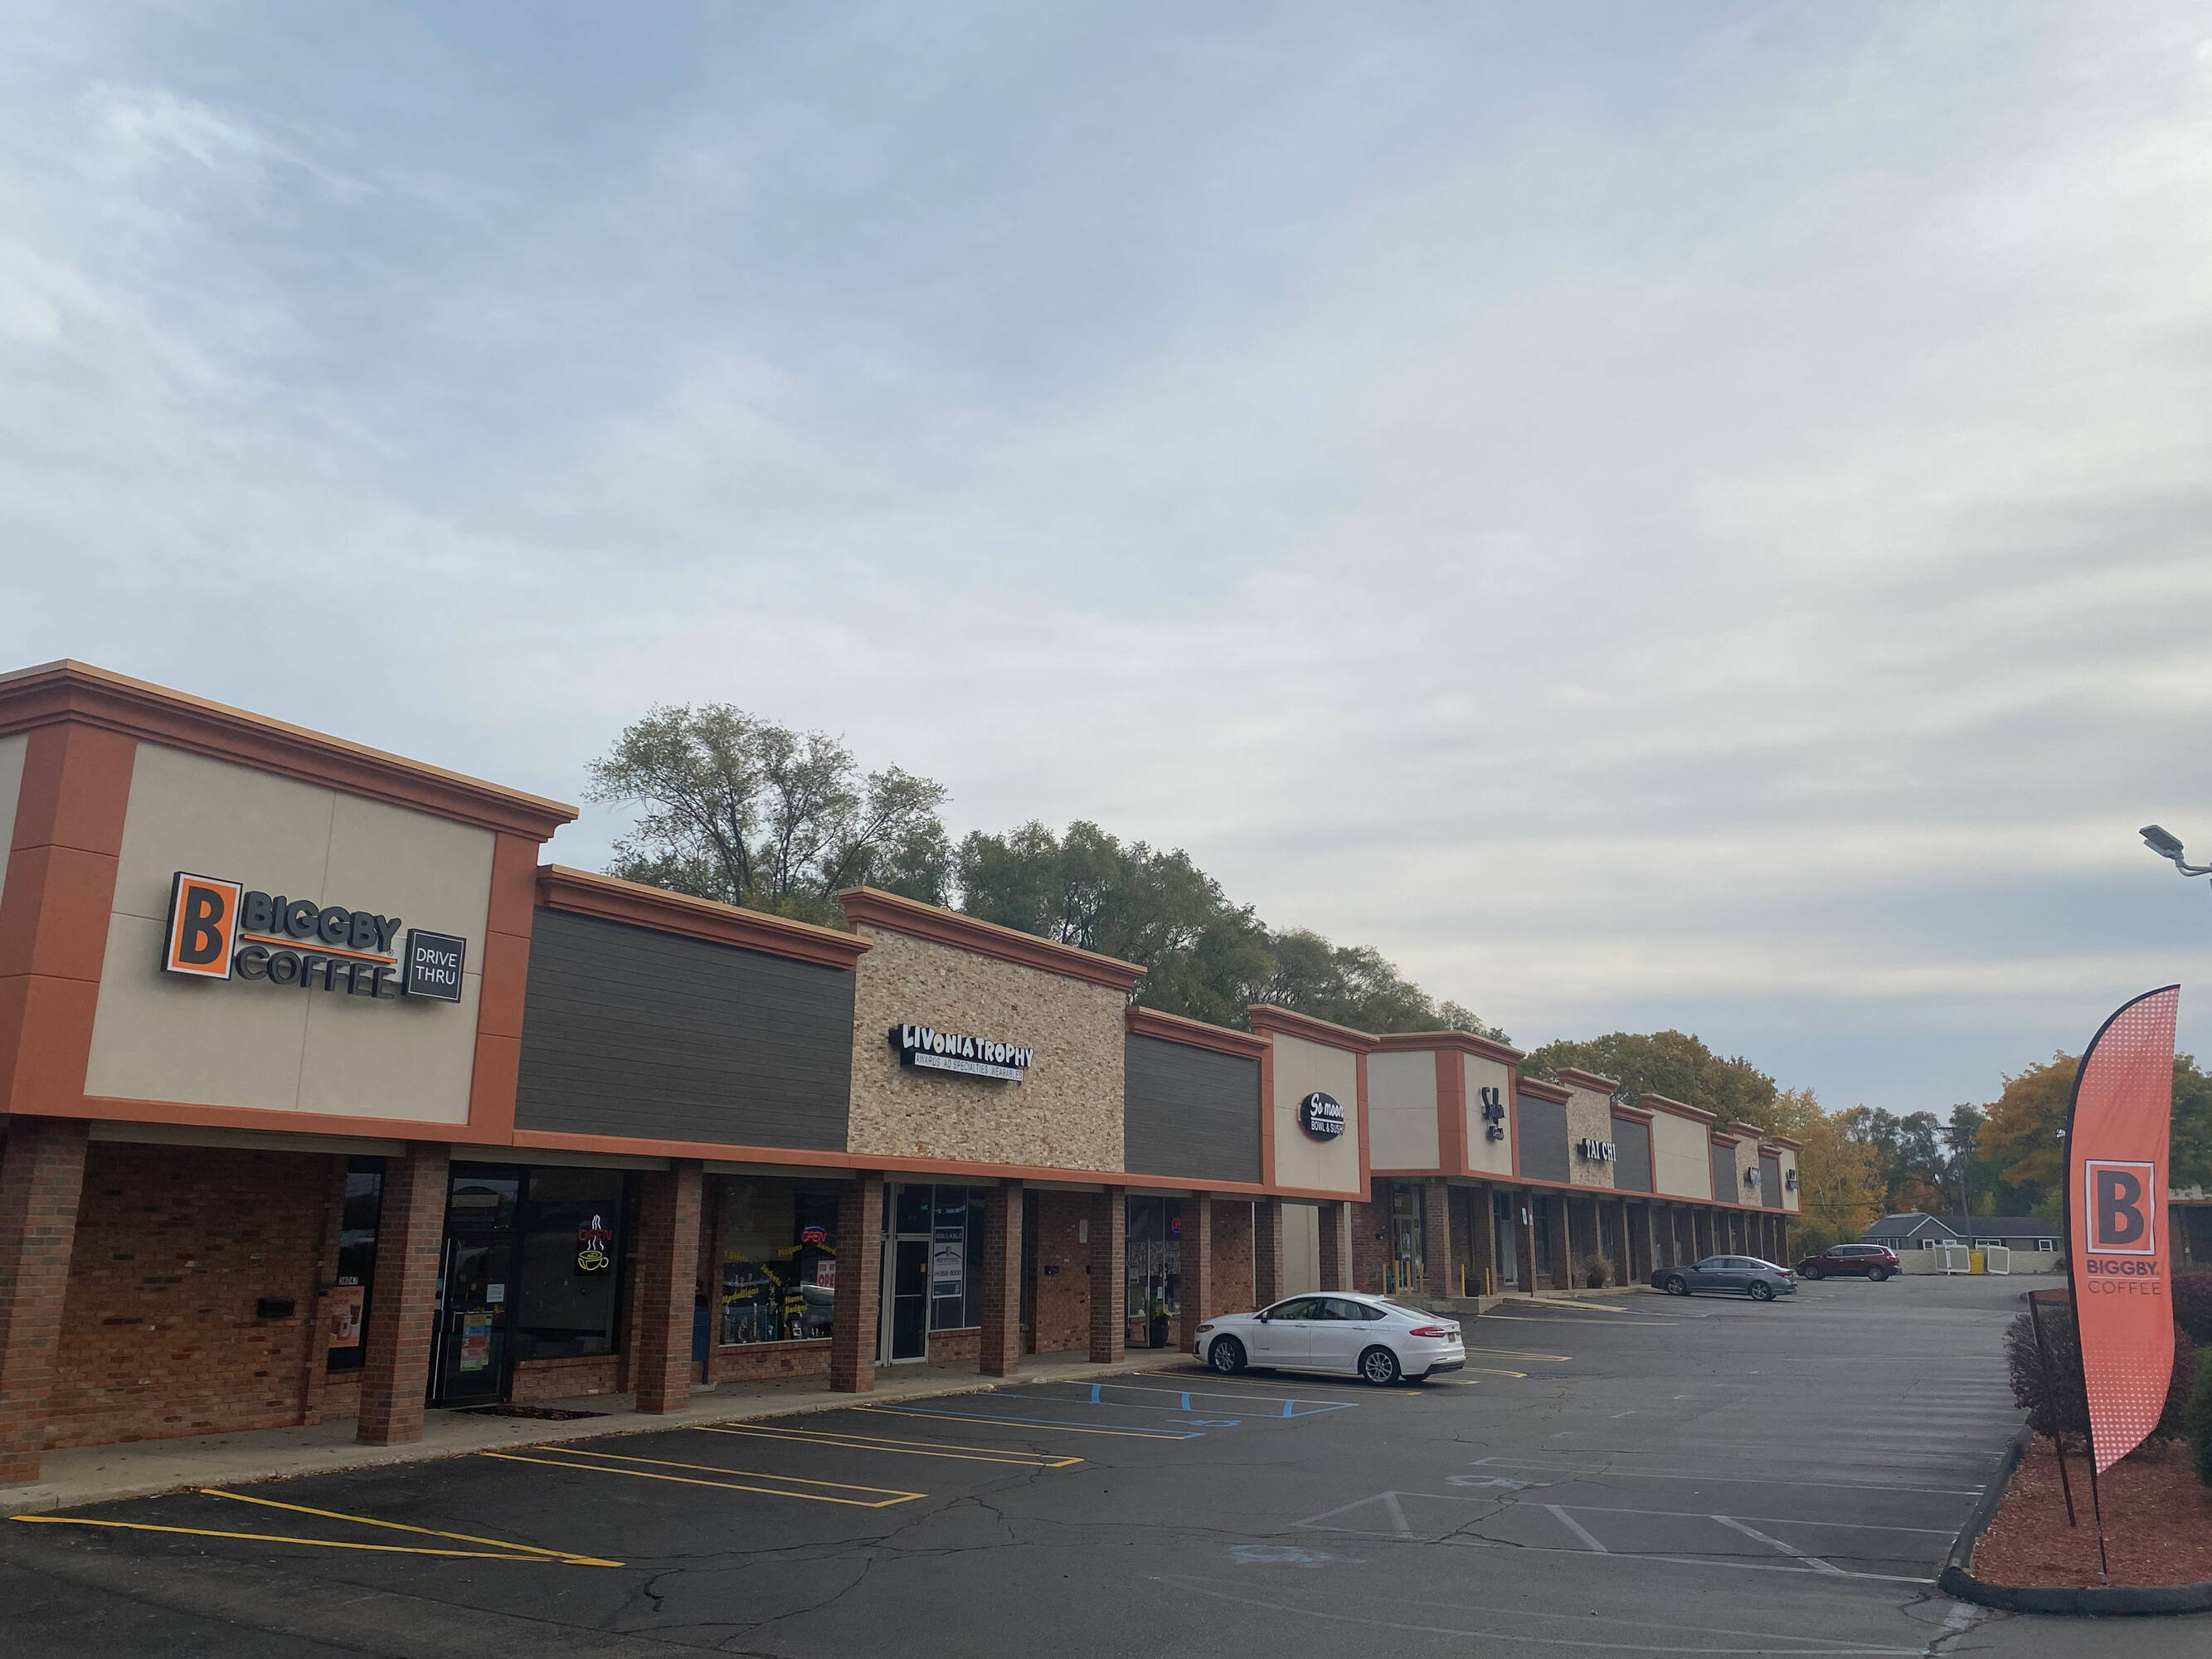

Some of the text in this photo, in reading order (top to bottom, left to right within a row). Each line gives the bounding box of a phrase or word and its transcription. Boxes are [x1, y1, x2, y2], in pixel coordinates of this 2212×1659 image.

[179, 886, 225, 965] B
[241, 891, 401, 951] BIGGBY
[416, 947, 458, 967] DRIVE
[236, 946, 396, 999] COFFEE
[416, 966, 456, 985] THRU
[902, 1024, 1034, 1068] LIVONIA TROPHY
[916, 1054, 941, 1067] AWARDS
[953, 1060, 989, 1074] SPECIALTIES
[991, 1066, 1023, 1080] WEARABLES
[1310, 1093, 1324, 1117] So
[1311, 1121, 1325, 1132] BOWL
[1586, 1139, 1616, 1162] TAI CHI
[2098, 1170, 2144, 1244] B
[577, 1228, 613, 1242] OPEN
[802, 1230, 828, 1243] OPEN
[2087, 1259, 2157, 1276] BIGGBY
[2088, 1281, 2161, 1295] COFFEE
